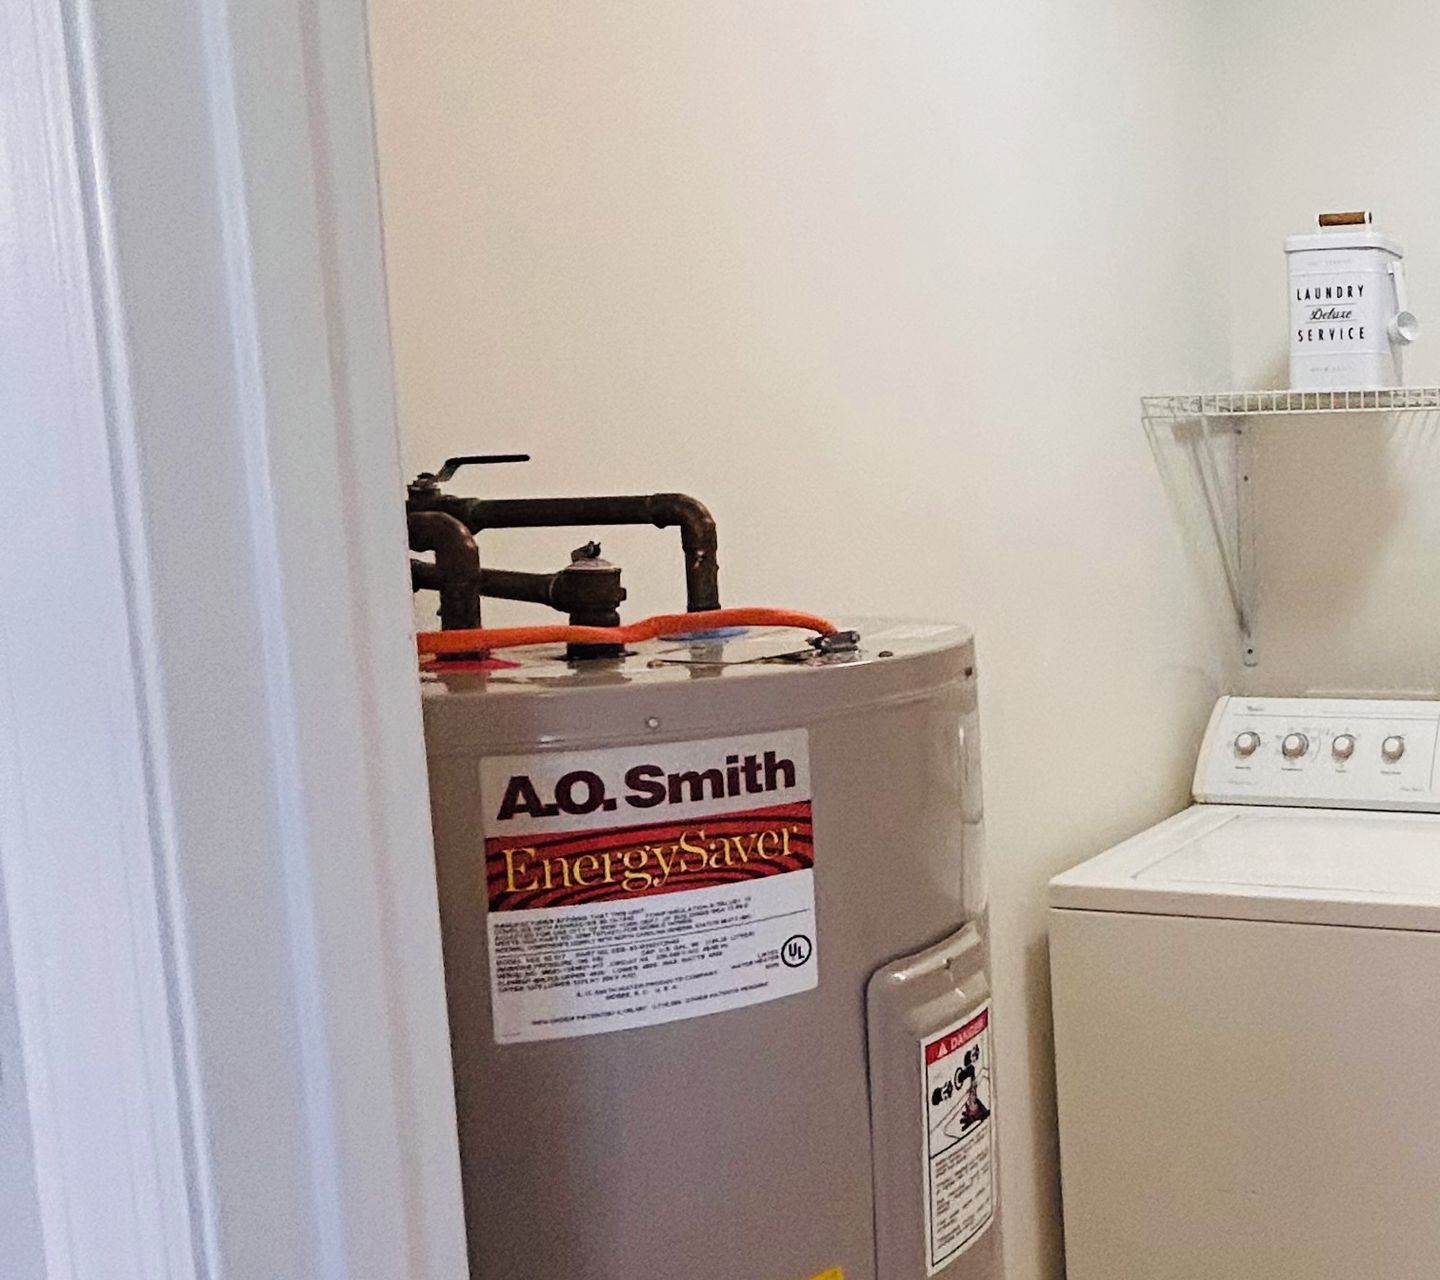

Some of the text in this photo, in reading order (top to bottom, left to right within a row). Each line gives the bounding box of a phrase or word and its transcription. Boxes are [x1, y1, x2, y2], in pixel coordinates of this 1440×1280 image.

[1296, 285, 1364, 301] LAUNDRY
[1310, 308, 1352, 321] Deluxe
[1297, 326, 1365, 342] SERVICE
[496, 751, 796, 820] A.O. Smith
[502, 827, 798, 892] EnergySaver
